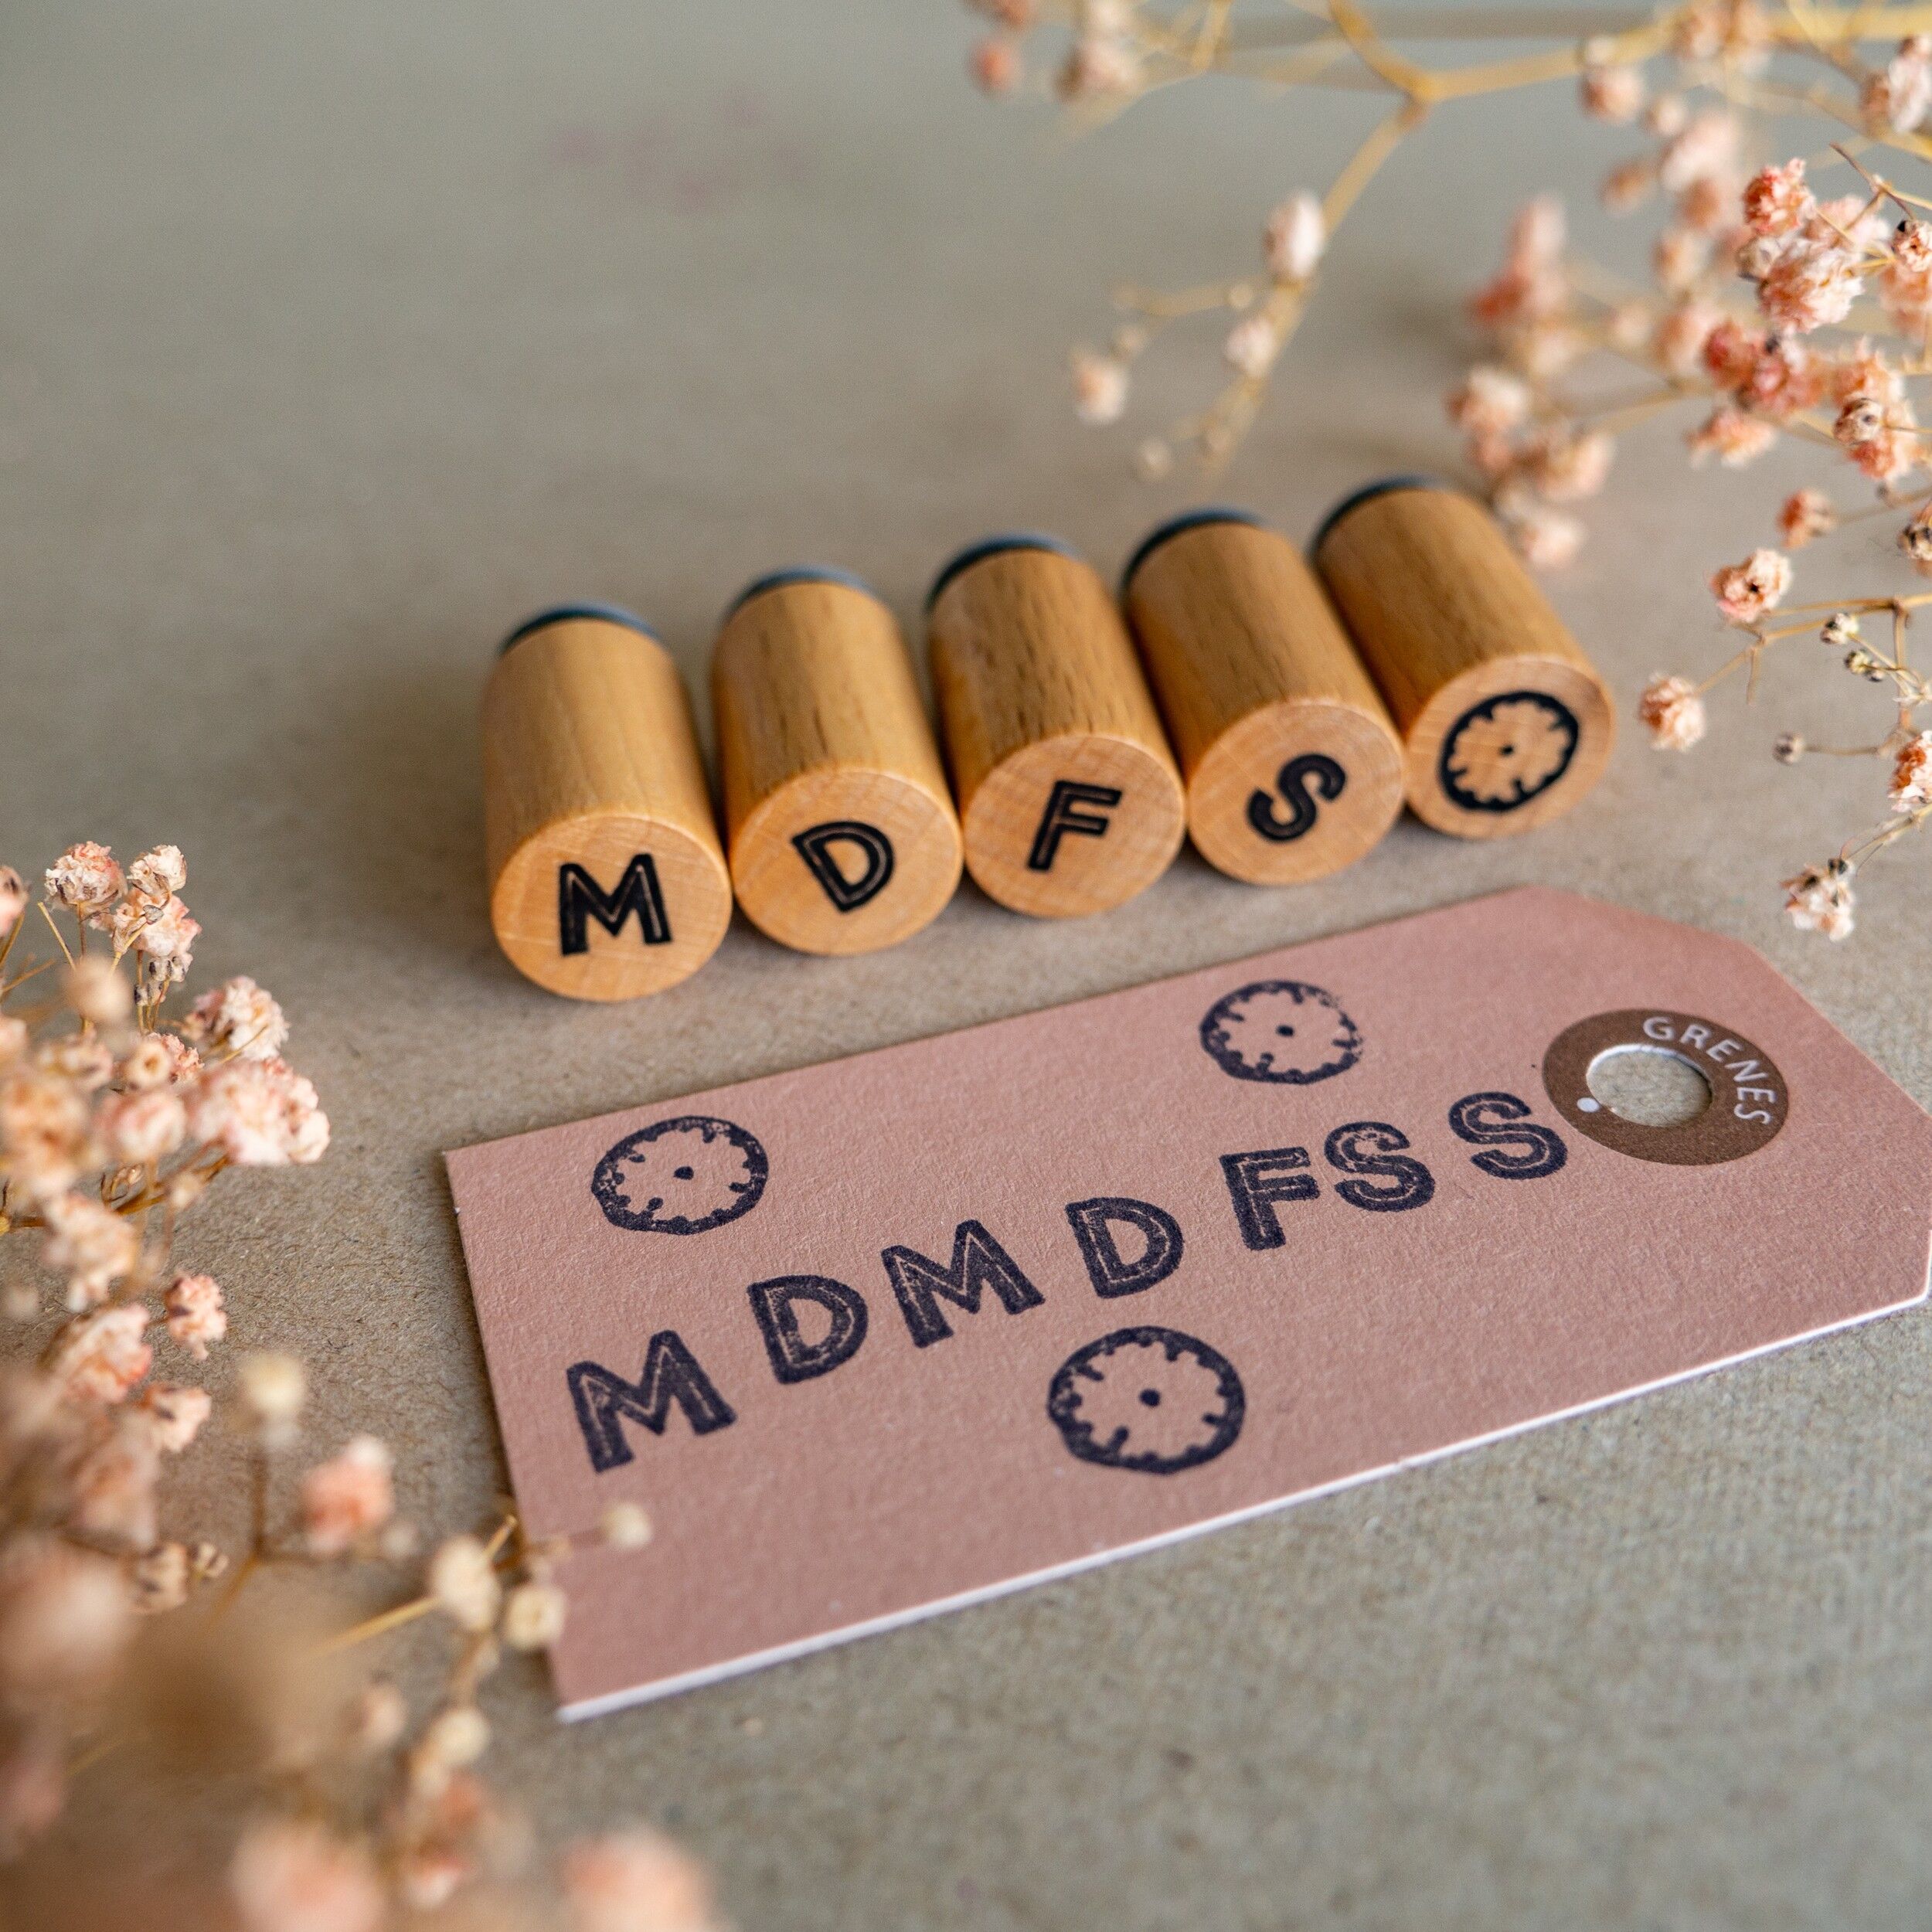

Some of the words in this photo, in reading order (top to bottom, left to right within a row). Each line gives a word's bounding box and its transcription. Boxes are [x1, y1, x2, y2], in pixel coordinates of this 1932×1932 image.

[1025, 778, 1124, 874] F
[1245, 752, 1348, 845] S
[558, 853, 672, 957] M
[790, 820, 896, 914] D
[1642, 1016, 1777, 1125] GRENES
